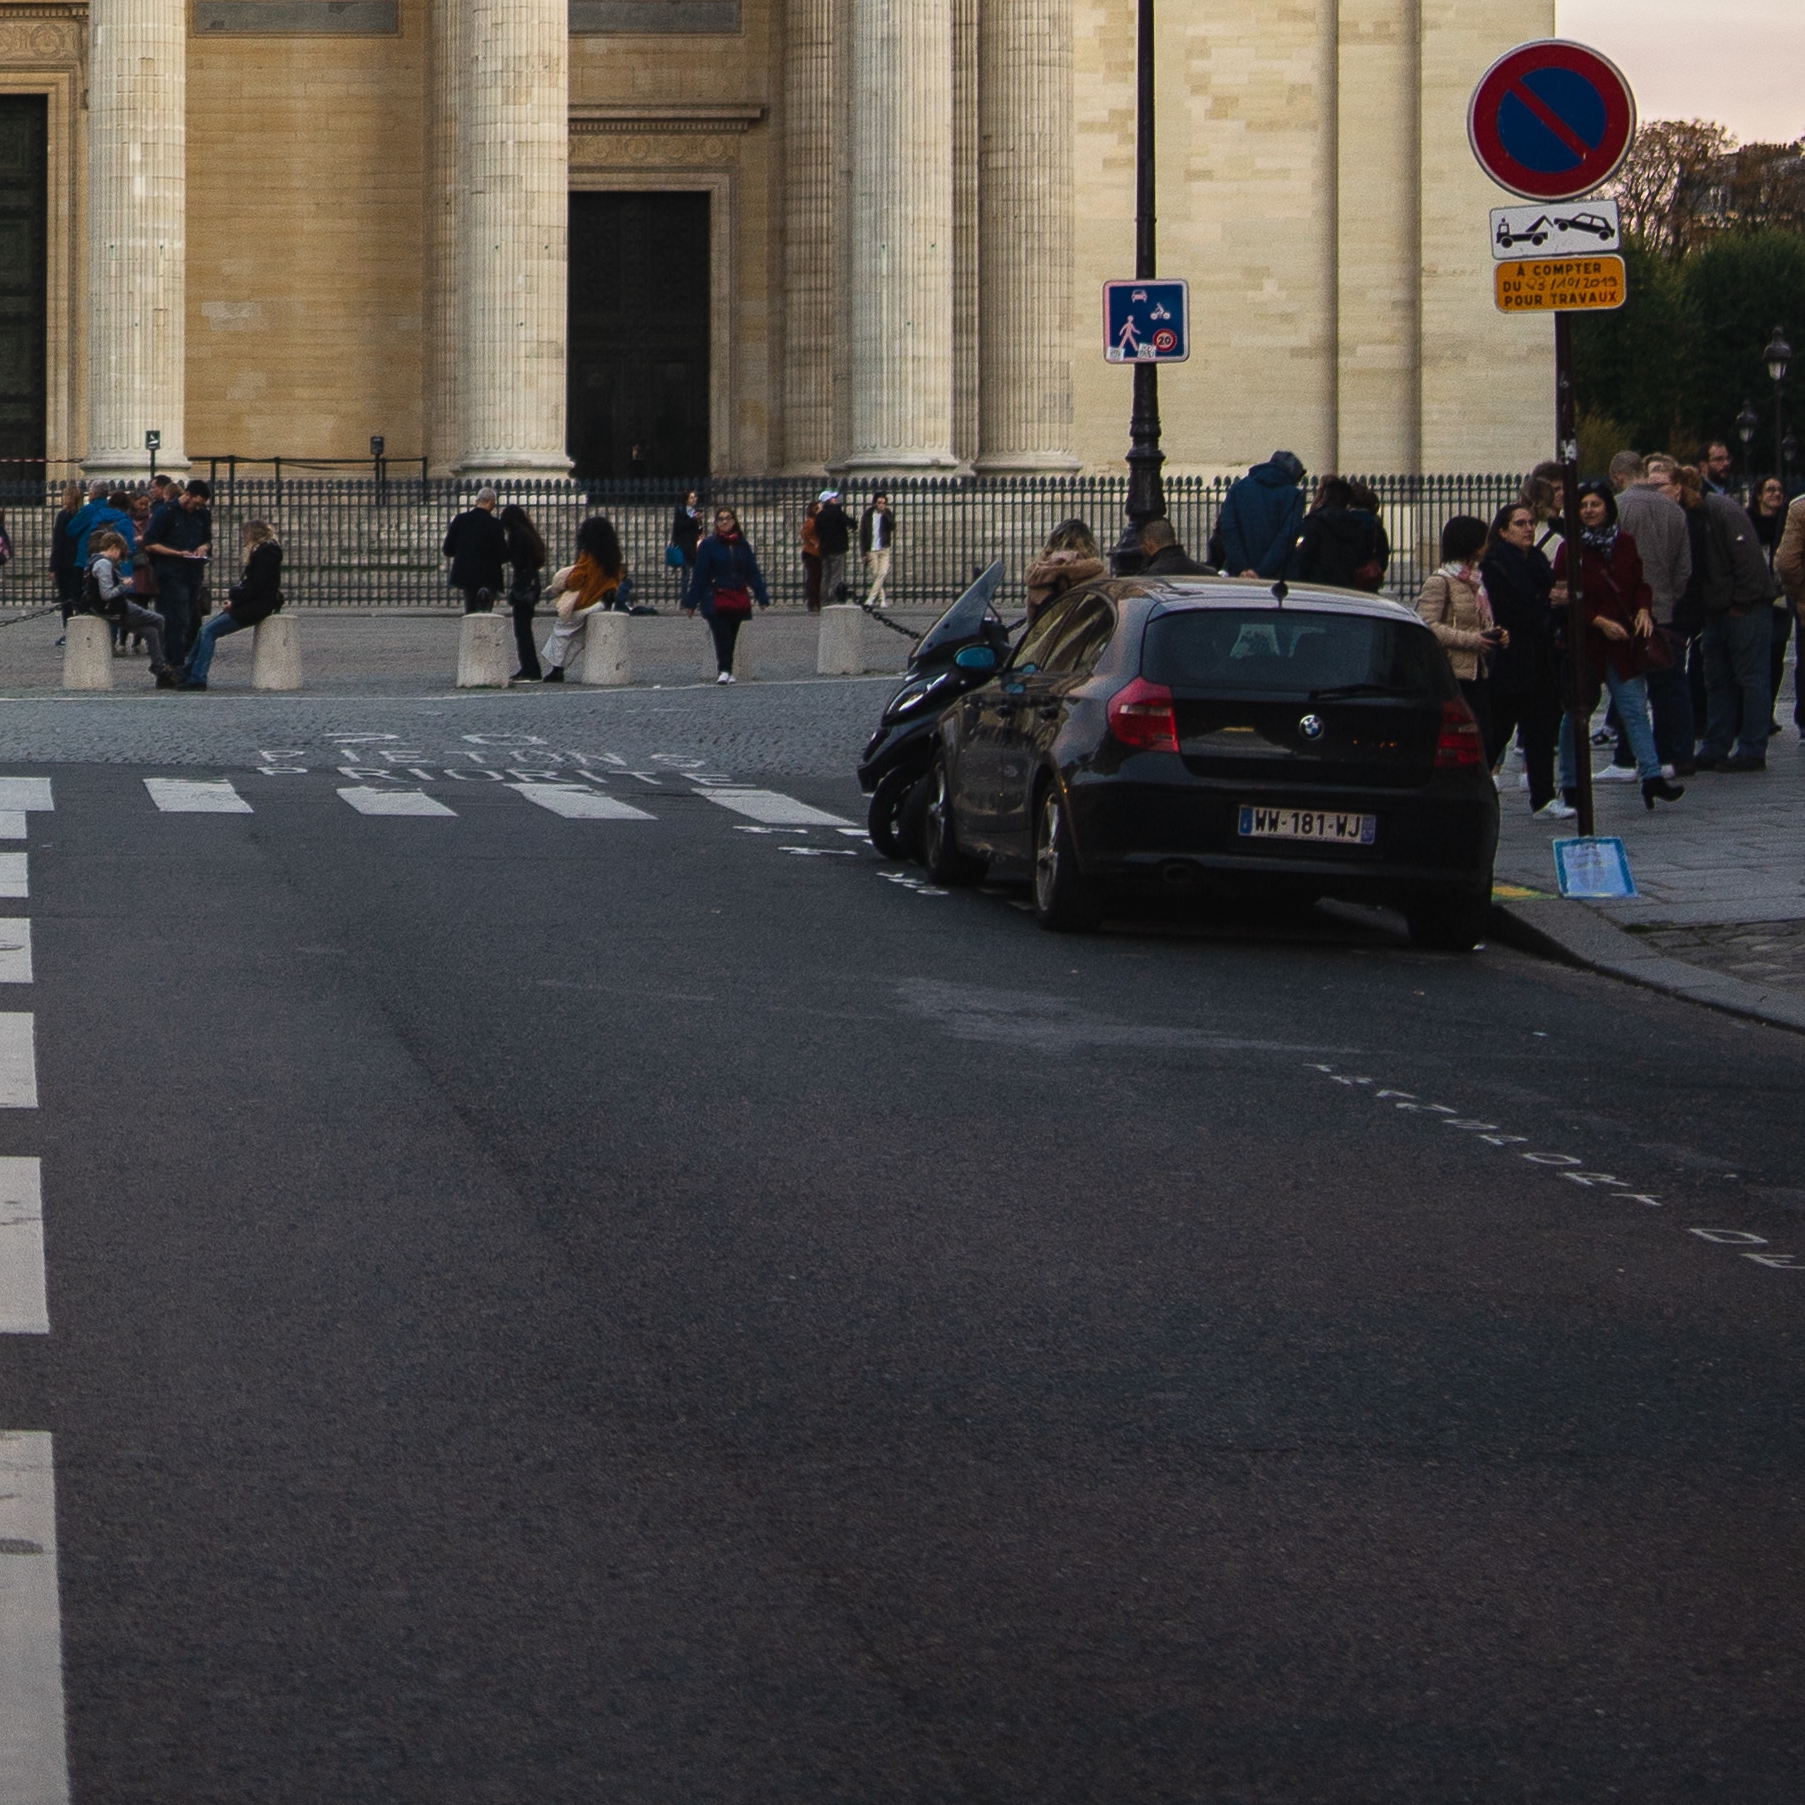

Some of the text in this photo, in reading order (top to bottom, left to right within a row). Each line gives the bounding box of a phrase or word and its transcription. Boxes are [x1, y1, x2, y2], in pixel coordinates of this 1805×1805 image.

[1533, 262, 1602, 276] COMPTER
[1502, 280, 1522, 292] DU
[1504, 291, 1617, 307] POUR TRAVAUX
[1157, 335, 1172, 346] 20
[258, 749, 707, 769] PIETONS
[256, 766, 758, 787] PRIORITE
[1254, 809, 1361, 838] WW-181-WJ
